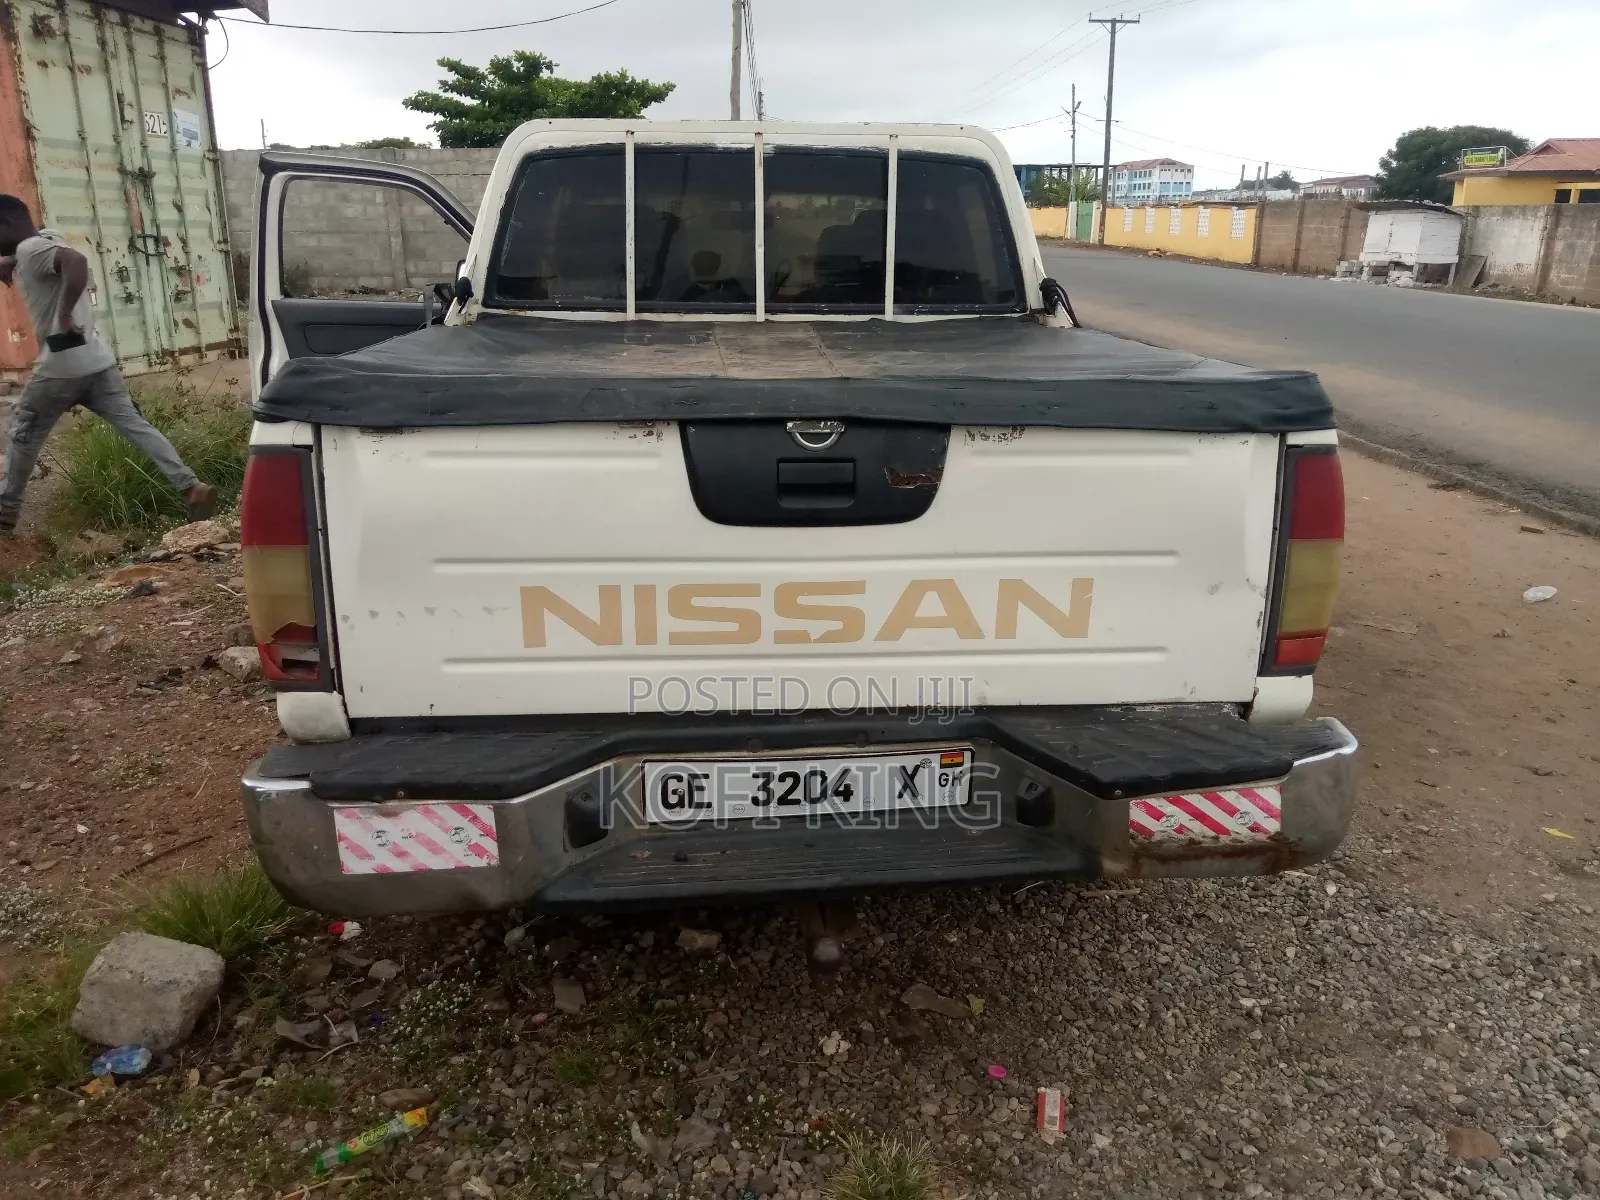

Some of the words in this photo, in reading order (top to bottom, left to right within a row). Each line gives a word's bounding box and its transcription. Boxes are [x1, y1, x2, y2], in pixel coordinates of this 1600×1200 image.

[519, 577, 1095, 649] NISSAN
[660, 772, 713, 809] GE
[751, 768, 855, 806] 3204
[897, 763, 921, 799] X
